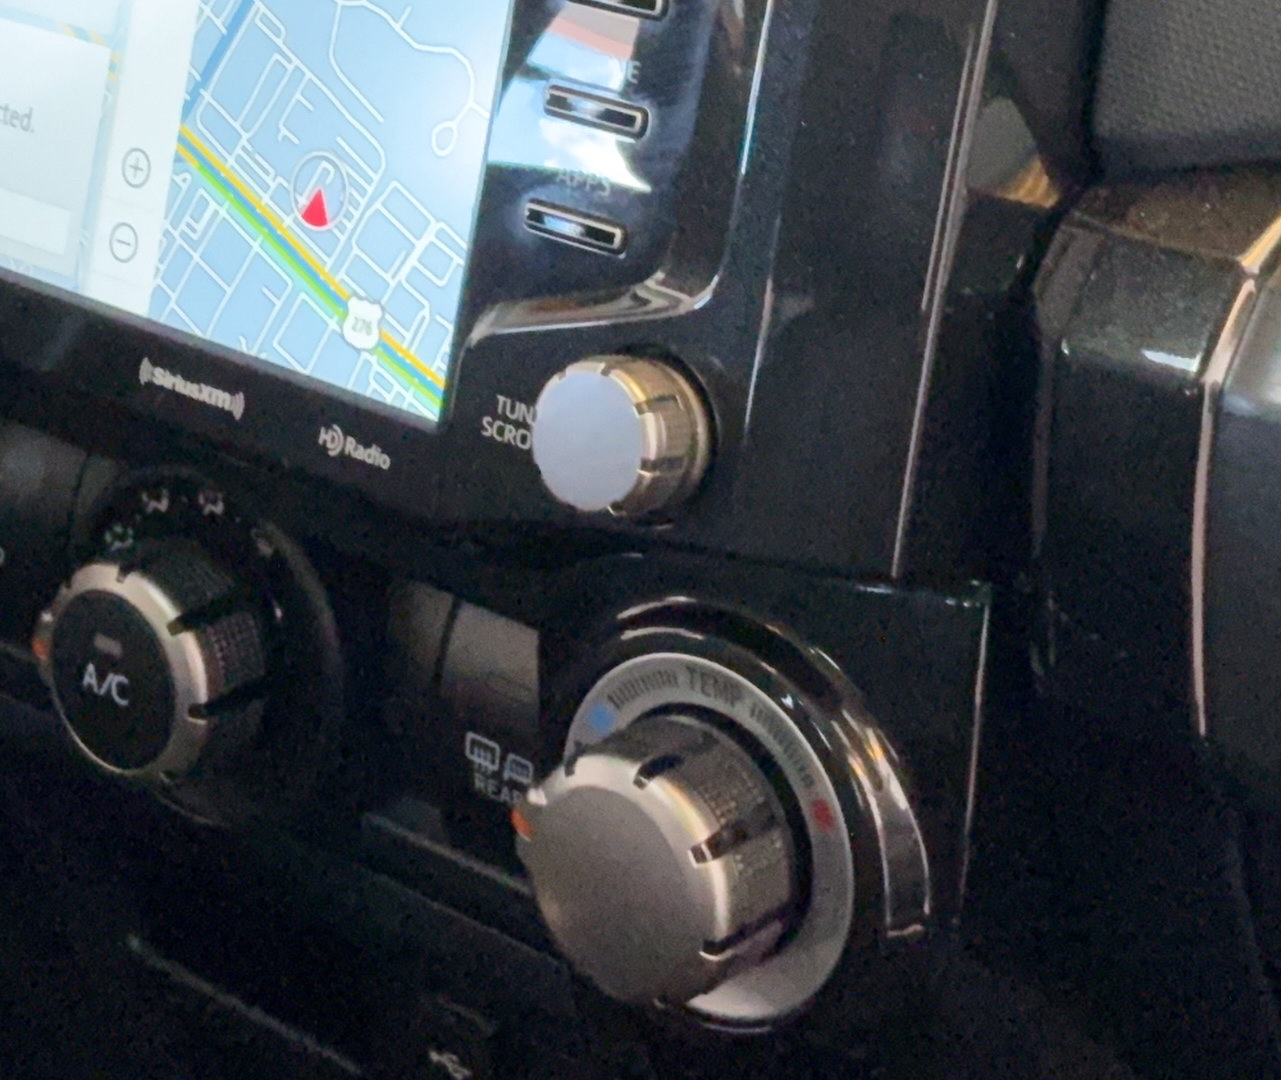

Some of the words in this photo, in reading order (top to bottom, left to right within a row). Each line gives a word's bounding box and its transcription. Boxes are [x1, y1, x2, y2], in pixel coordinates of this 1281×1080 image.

[496, 394, 536, 426] TUN
[481, 415, 532, 450] SCRO
[344, 435, 391, 470] Radio
[82, 661, 129, 707] A/C
